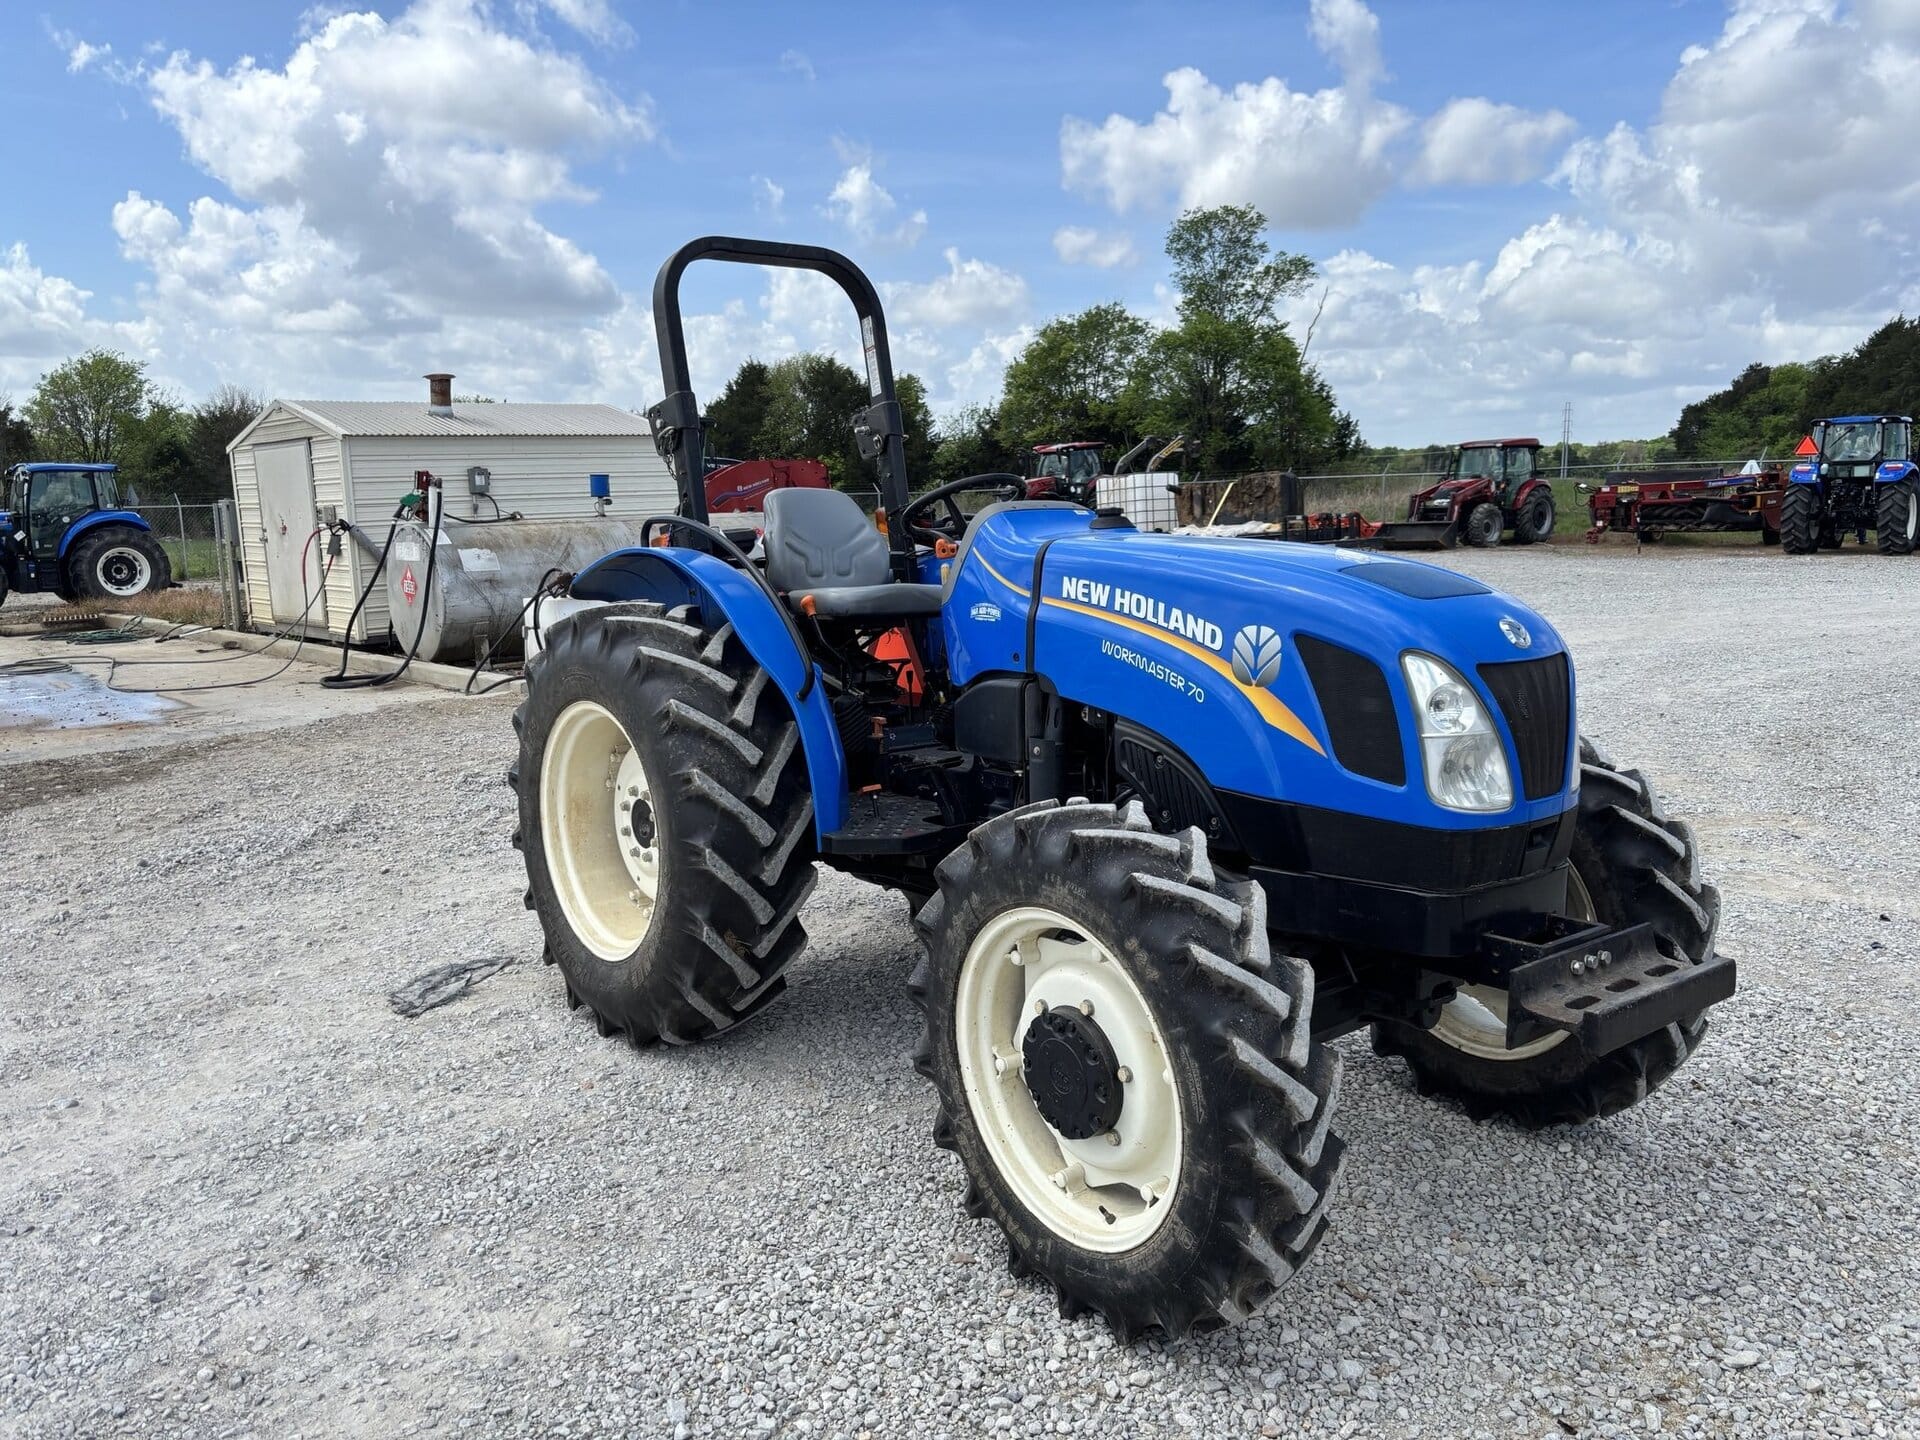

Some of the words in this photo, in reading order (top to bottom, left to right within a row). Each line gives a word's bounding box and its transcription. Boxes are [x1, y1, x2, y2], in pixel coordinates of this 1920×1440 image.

[1062, 576, 1110, 608] NEW
[1114, 587, 1223, 651] HOLLAND
[1101, 639, 1185, 693] WORKMASTER
[1188, 681, 1205, 703] 70
